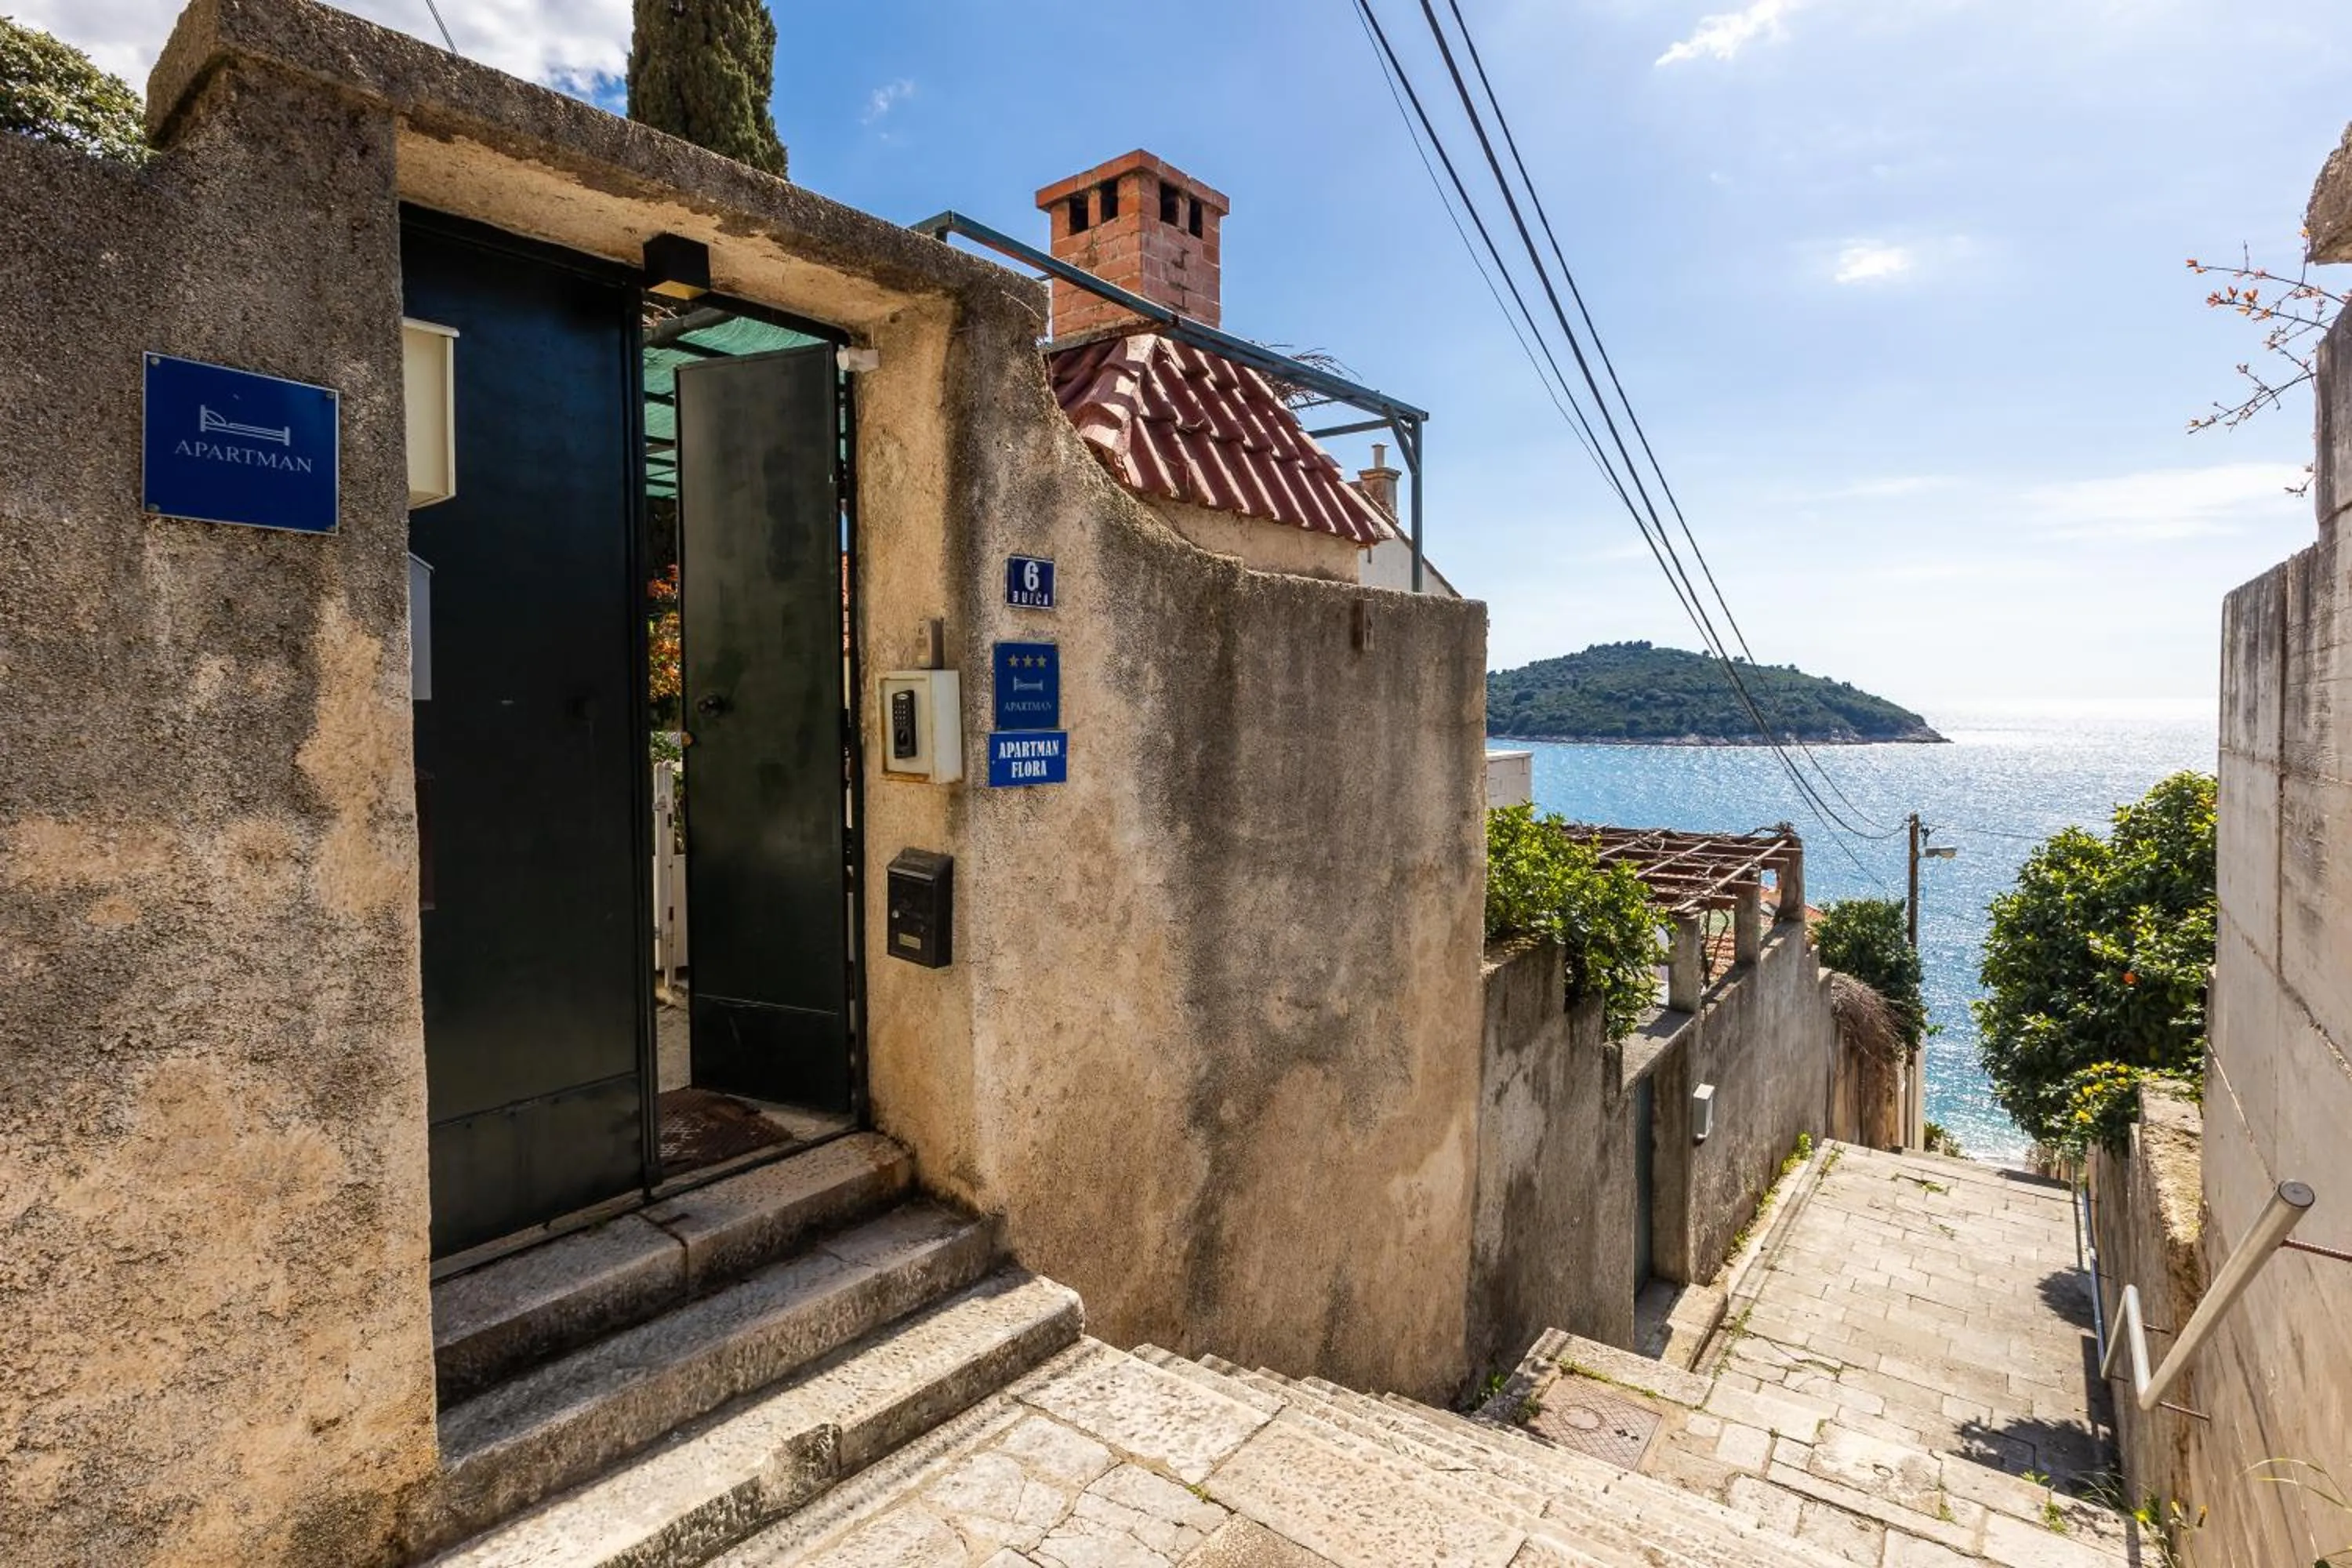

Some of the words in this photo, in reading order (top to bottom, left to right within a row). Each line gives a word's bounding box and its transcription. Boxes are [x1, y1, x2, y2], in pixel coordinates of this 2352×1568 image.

[175, 439, 313, 474] APARTMAN
[1023, 561, 1040, 592] 6
[1004, 702, 1052, 712] APARTMAN
[998, 739, 1059, 759] APARTMAN
[1011, 760, 1047, 779] FLORA
